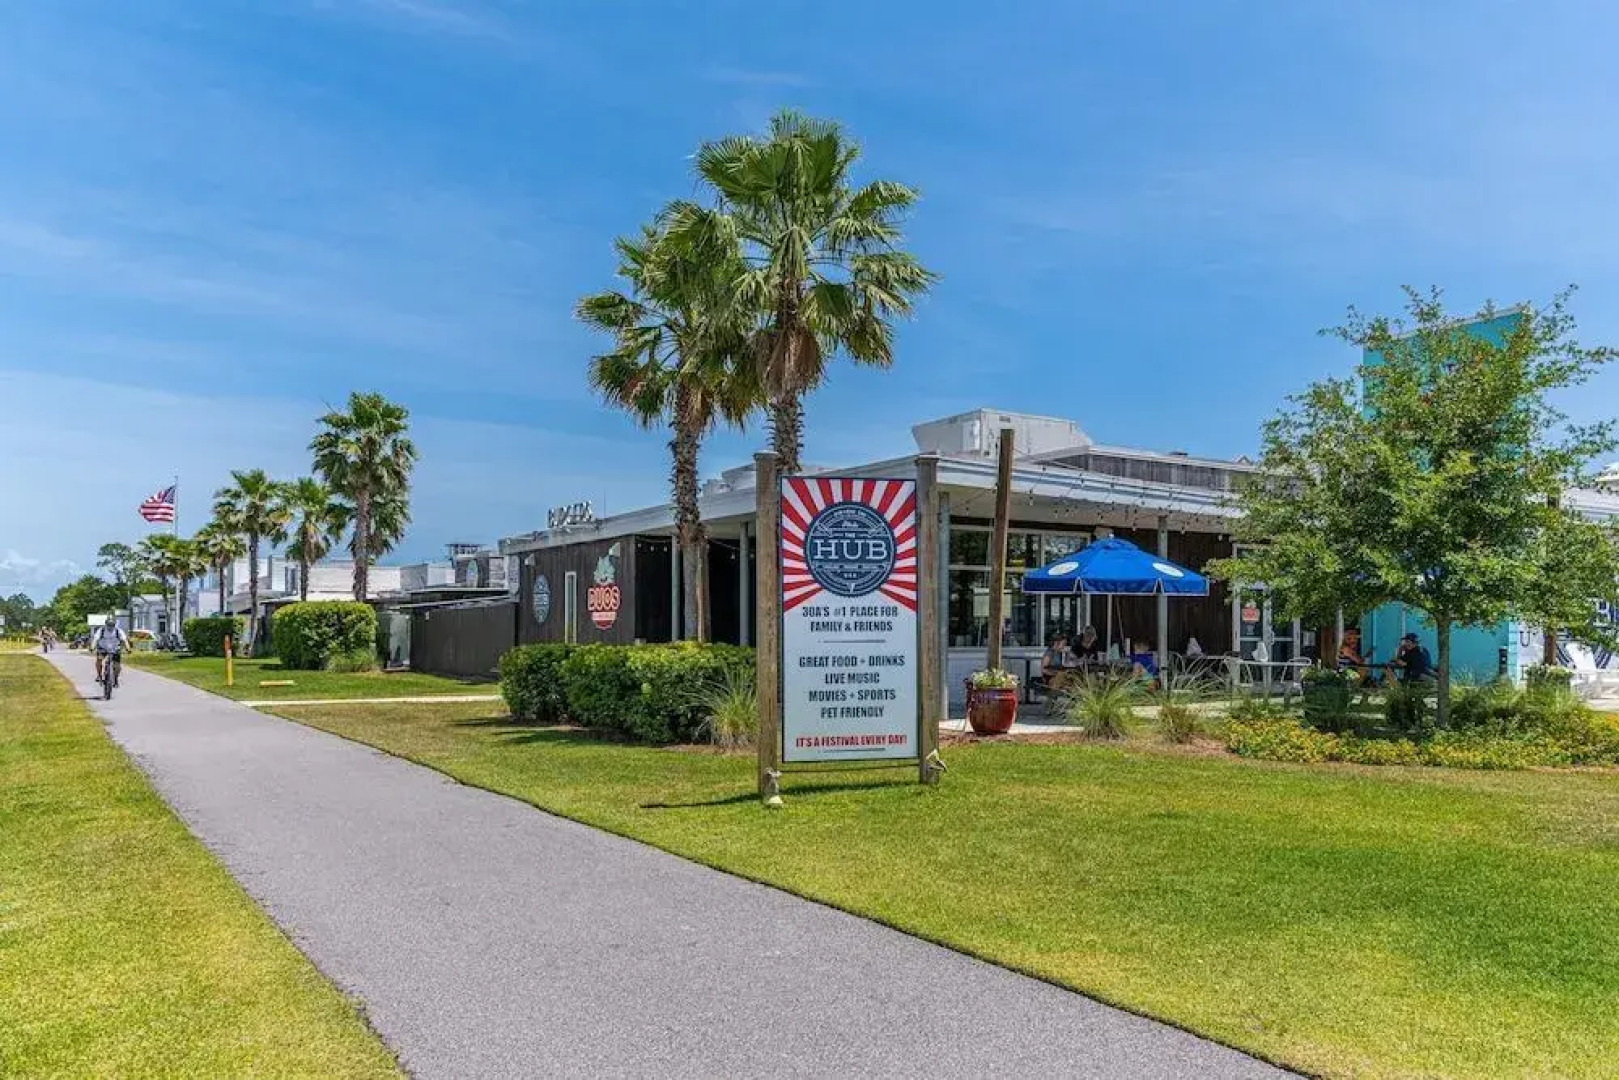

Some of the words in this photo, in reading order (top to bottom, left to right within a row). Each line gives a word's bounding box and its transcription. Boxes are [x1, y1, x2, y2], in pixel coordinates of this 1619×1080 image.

[813, 539, 888, 560] HUB
[849, 606, 879, 617] PLACE
[880, 606, 898, 617] FOR
[810, 621, 842, 633] FAMILY
[844, 624, 853, 632] &
[854, 621, 893, 632] FRIENDS
[799, 656, 829, 667] GREAT
[831, 656, 857, 667] FOOD
[868, 655, 906, 667] DRINKS
[824, 673, 845, 684] LIVE
[847, 672, 880, 684] MUSIC
[809, 690, 847, 702] MOVIES
[857, 689, 896, 701] SPORTS
[820, 707, 838, 719] PET
[840, 706, 884, 718] FRIENDLY
[796, 737, 813, 748] IT'S
[813, 737, 820, 748] A
[821, 736, 859, 747] FESTIVAL
[861, 735, 886, 746] EVERY
